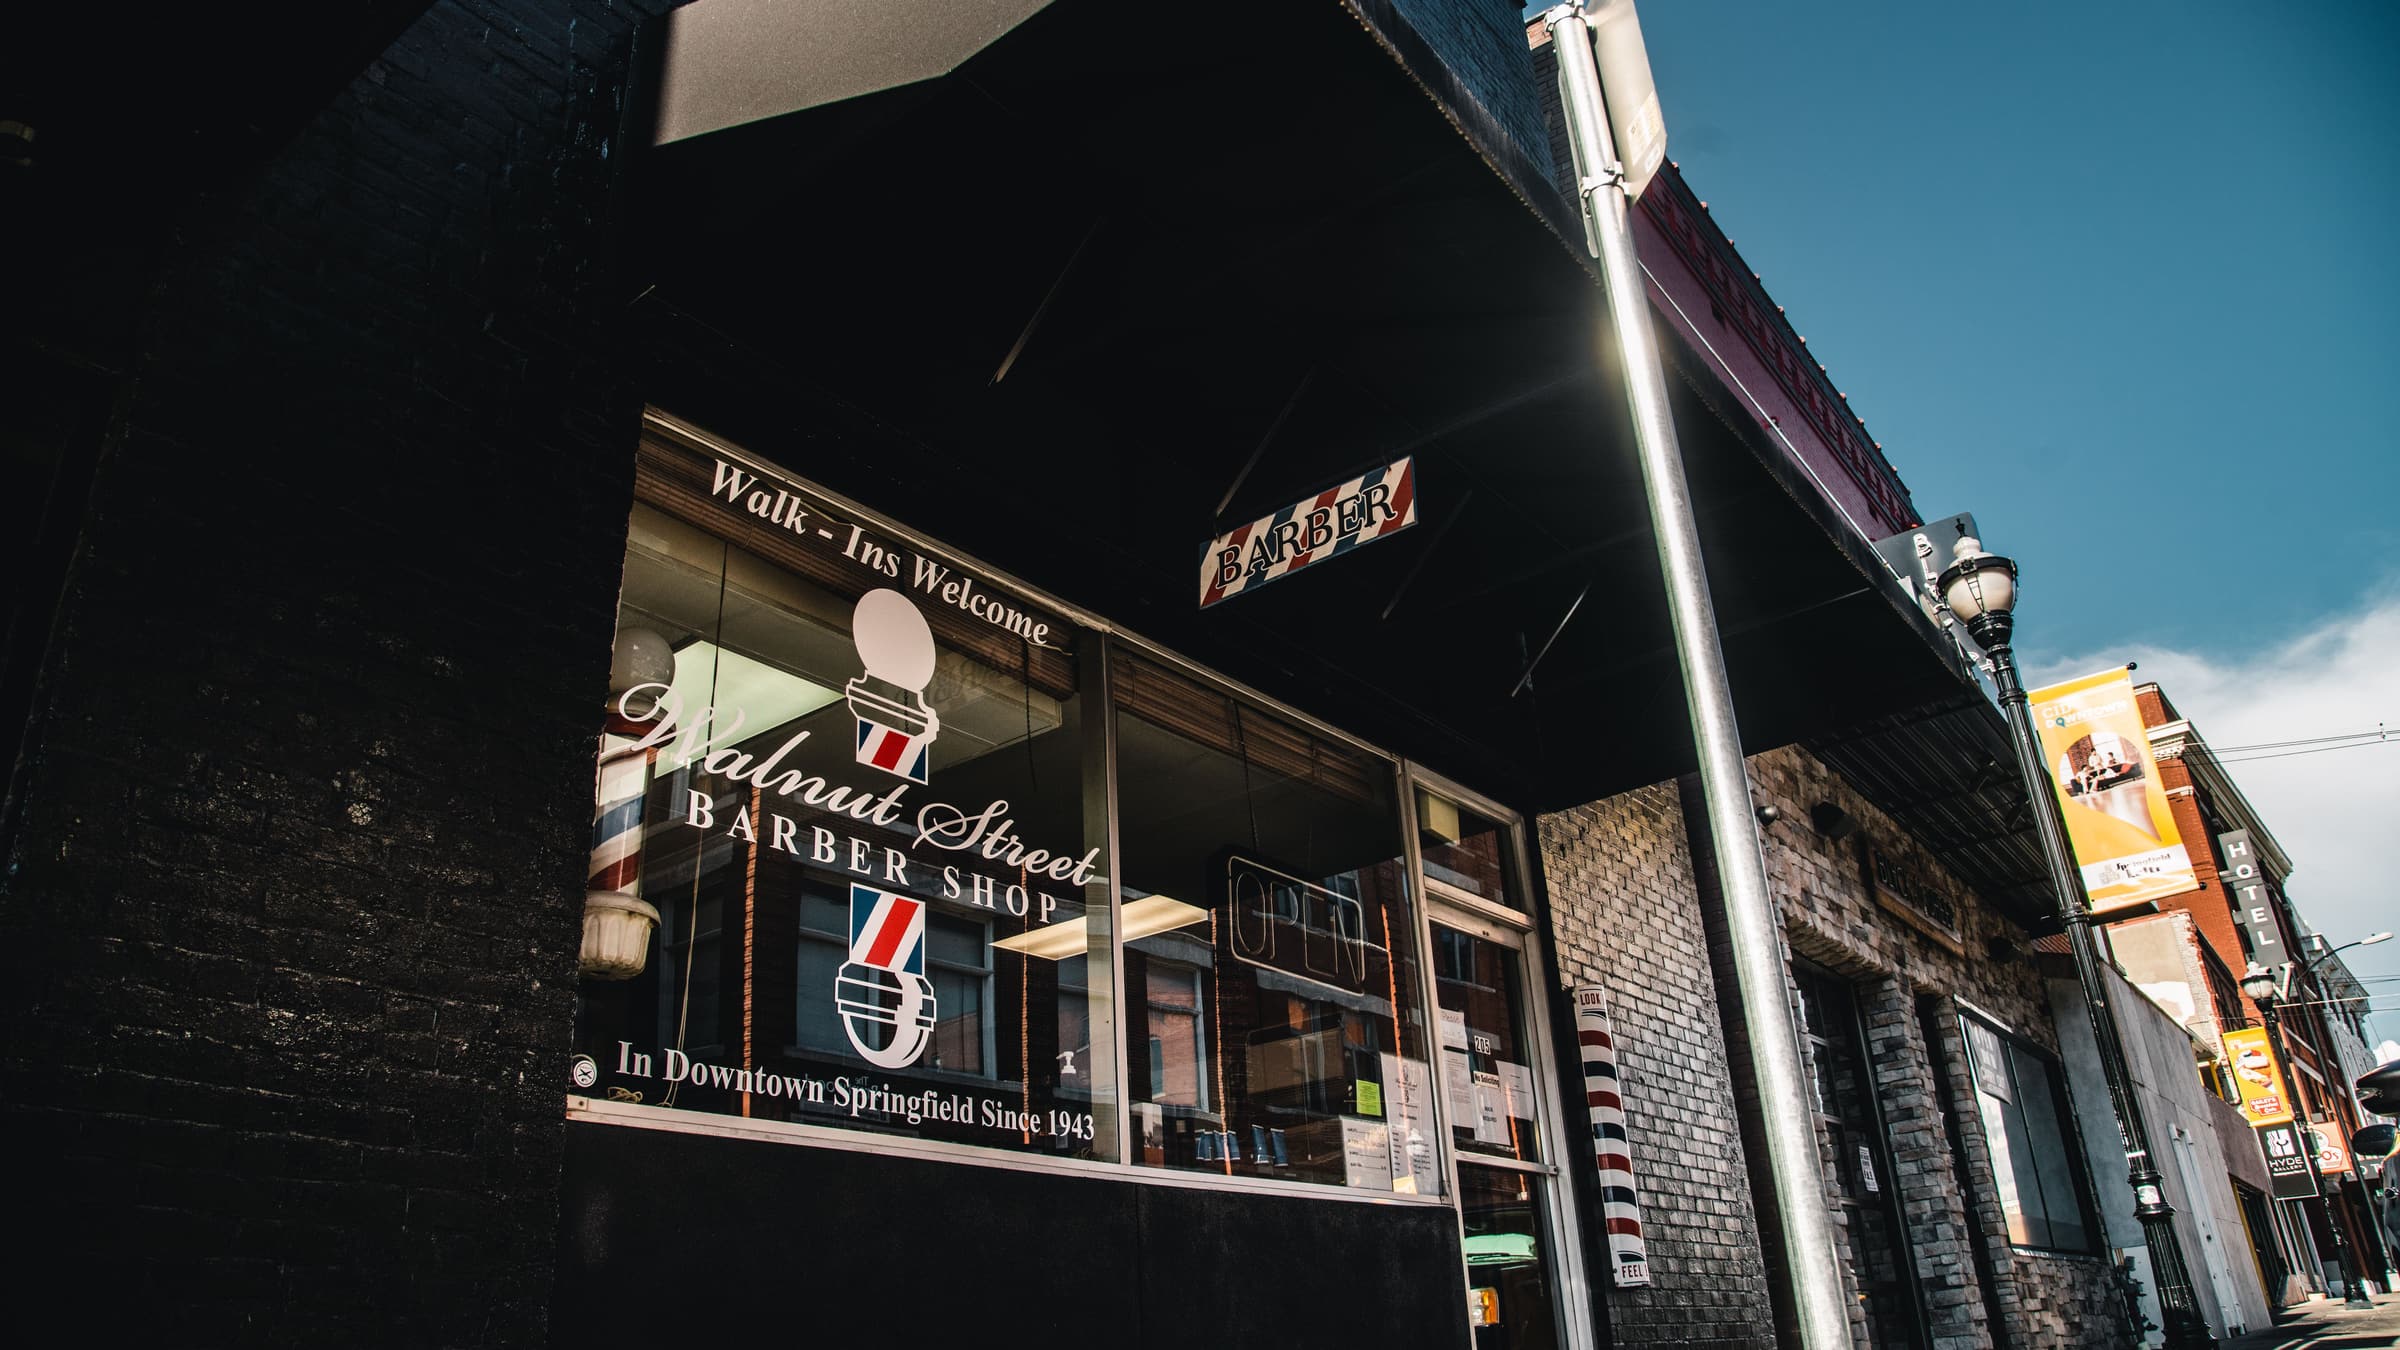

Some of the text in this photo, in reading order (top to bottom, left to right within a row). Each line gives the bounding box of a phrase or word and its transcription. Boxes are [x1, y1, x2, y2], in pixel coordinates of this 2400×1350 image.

[712, 459, 809, 535] Walk
[841, 523, 901, 578] Ins
[914, 554, 1049, 645] Welcome
[1216, 483, 1397, 588] BARBER
[619, 683, 1100, 887] Walnut Street
[685, 789, 1057, 924] BARBER SHOP
[2228, 842, 2275, 946] HOTEL
[1236, 872, 1361, 985] OPEN
[1474, 1036, 1491, 1054] 205
[1580, 993, 1601, 1005] LOOK
[616, 1040, 652, 1078] In
[662, 1048, 824, 1103] Downtown
[834, 1076, 974, 1125] Springfield
[981, 1099, 1041, 1133] Since
[1048, 1109, 1095, 1140] 1943
[2269, 1156, 2304, 1168] HYDE
[1622, 1264, 1643, 1278] FEEL
